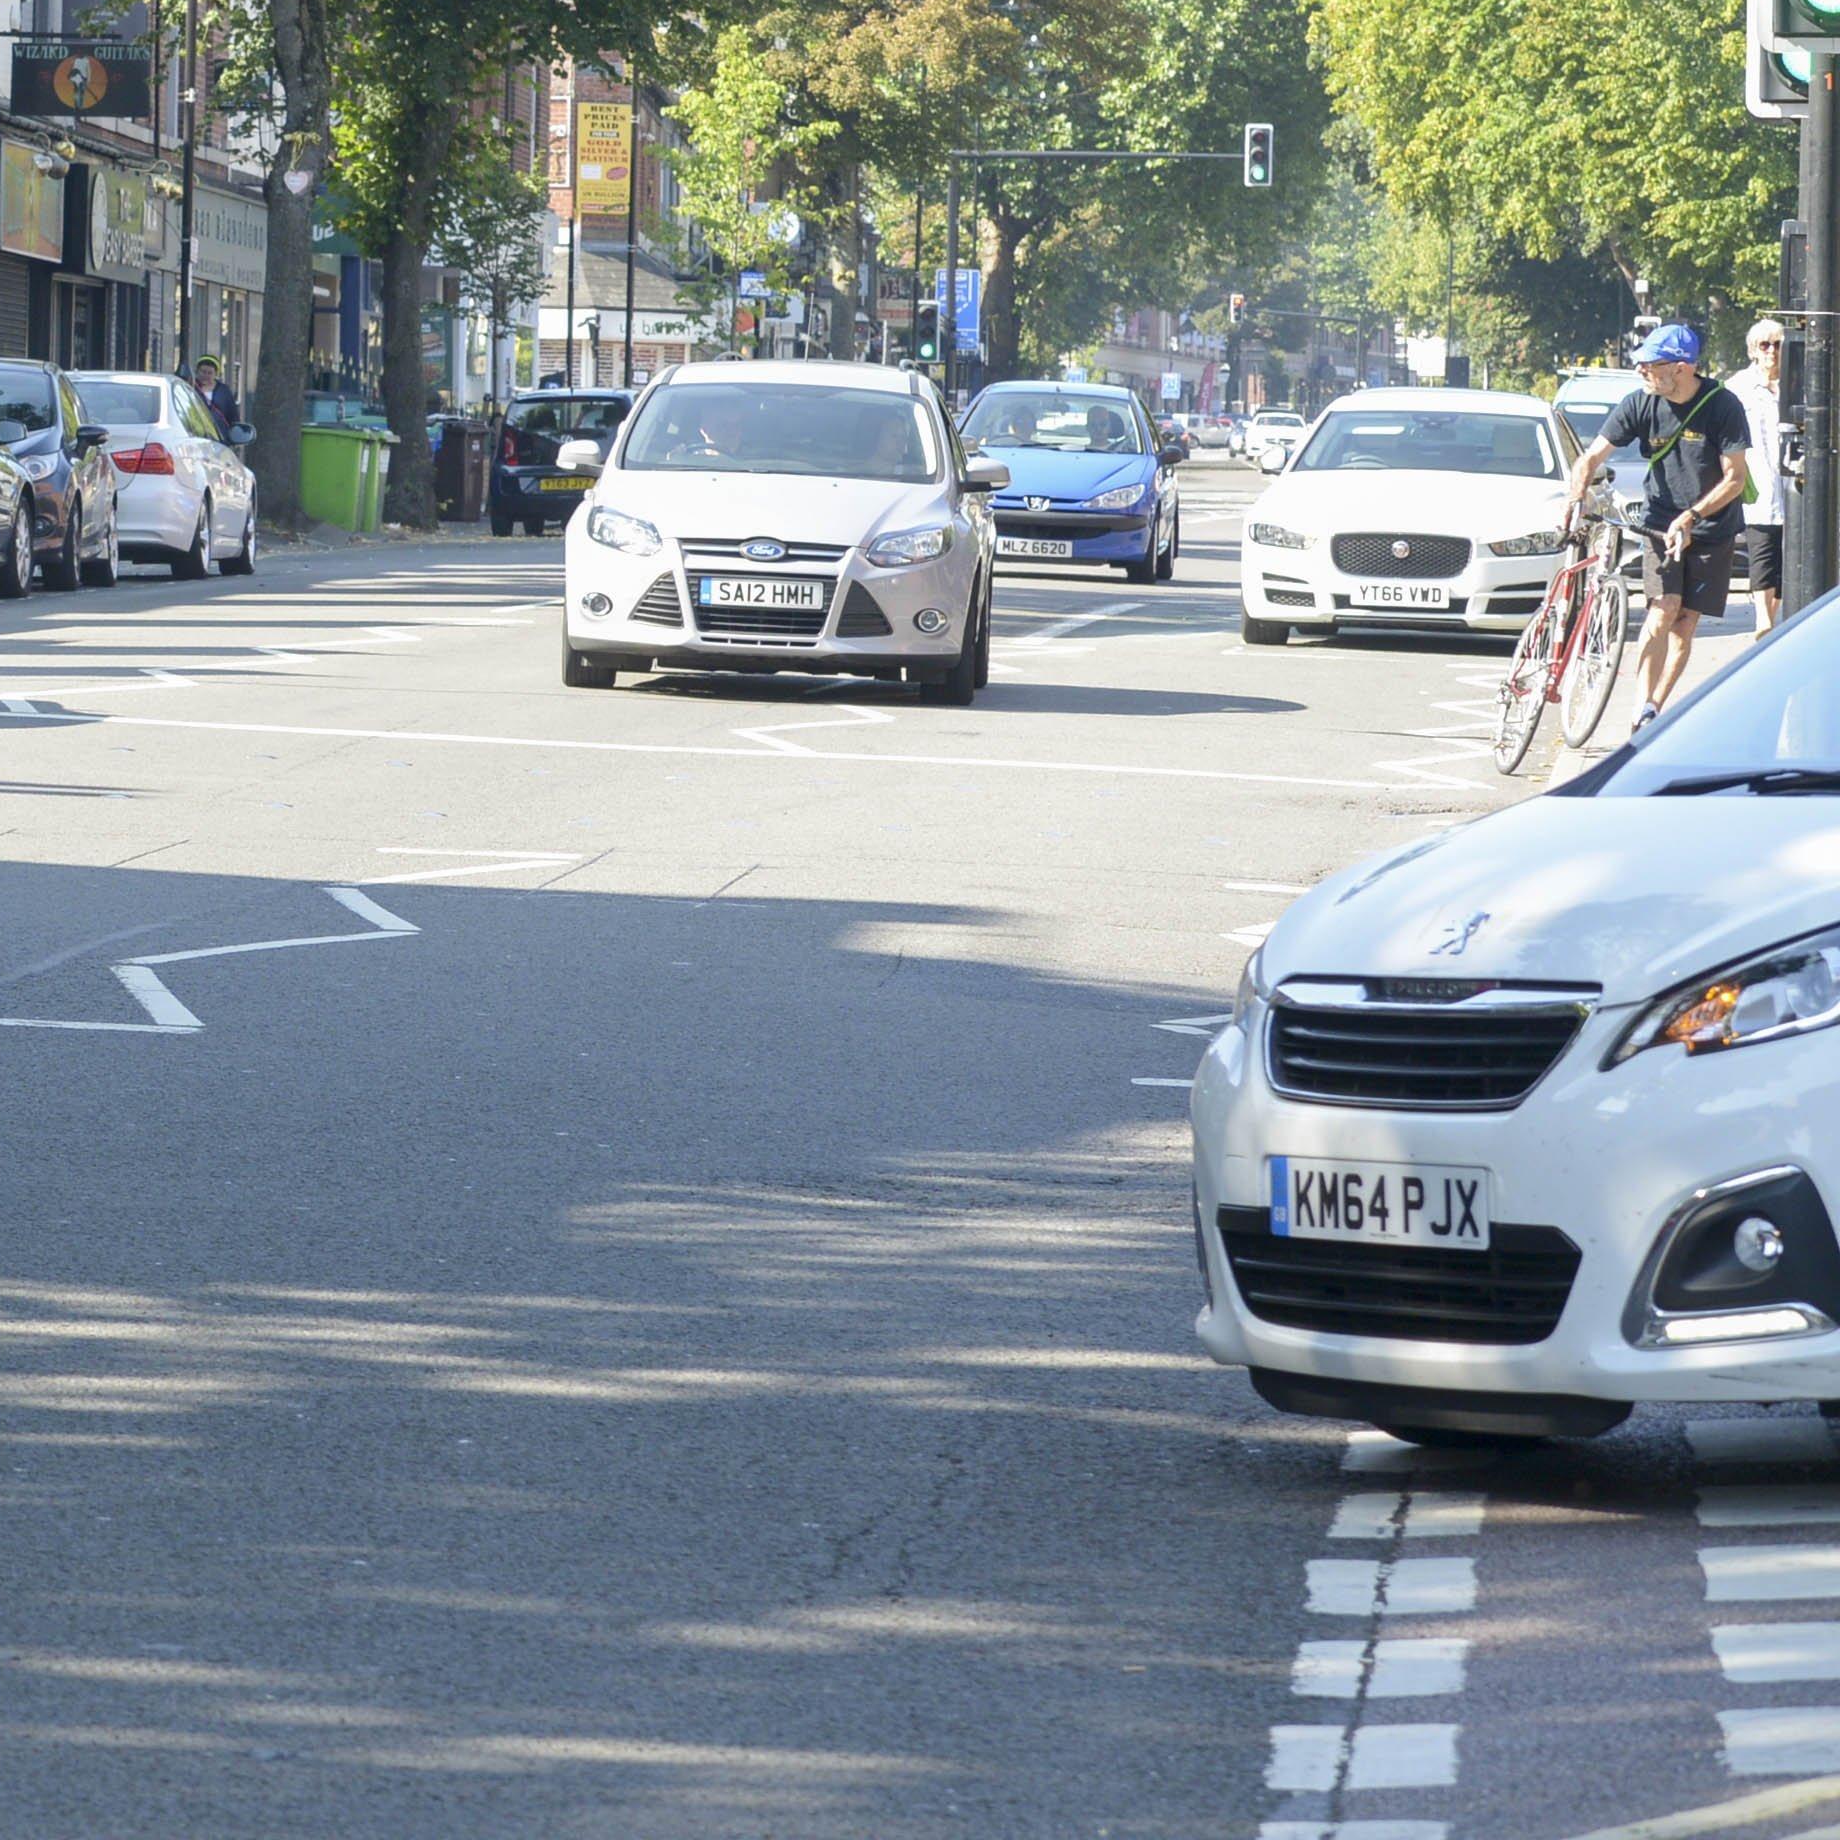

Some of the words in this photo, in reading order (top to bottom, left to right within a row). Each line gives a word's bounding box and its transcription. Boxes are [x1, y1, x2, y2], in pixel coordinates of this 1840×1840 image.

[1002, 539, 1028, 553] MLZ
[1032, 542, 1067, 555] 6620
[719, 582, 765, 603] SA12
[772, 585, 813, 605] HMH
[1359, 585, 1403, 601] YT66
[1409, 587, 1442, 603] VWD
[1294, 1169, 1389, 1232] KM64
